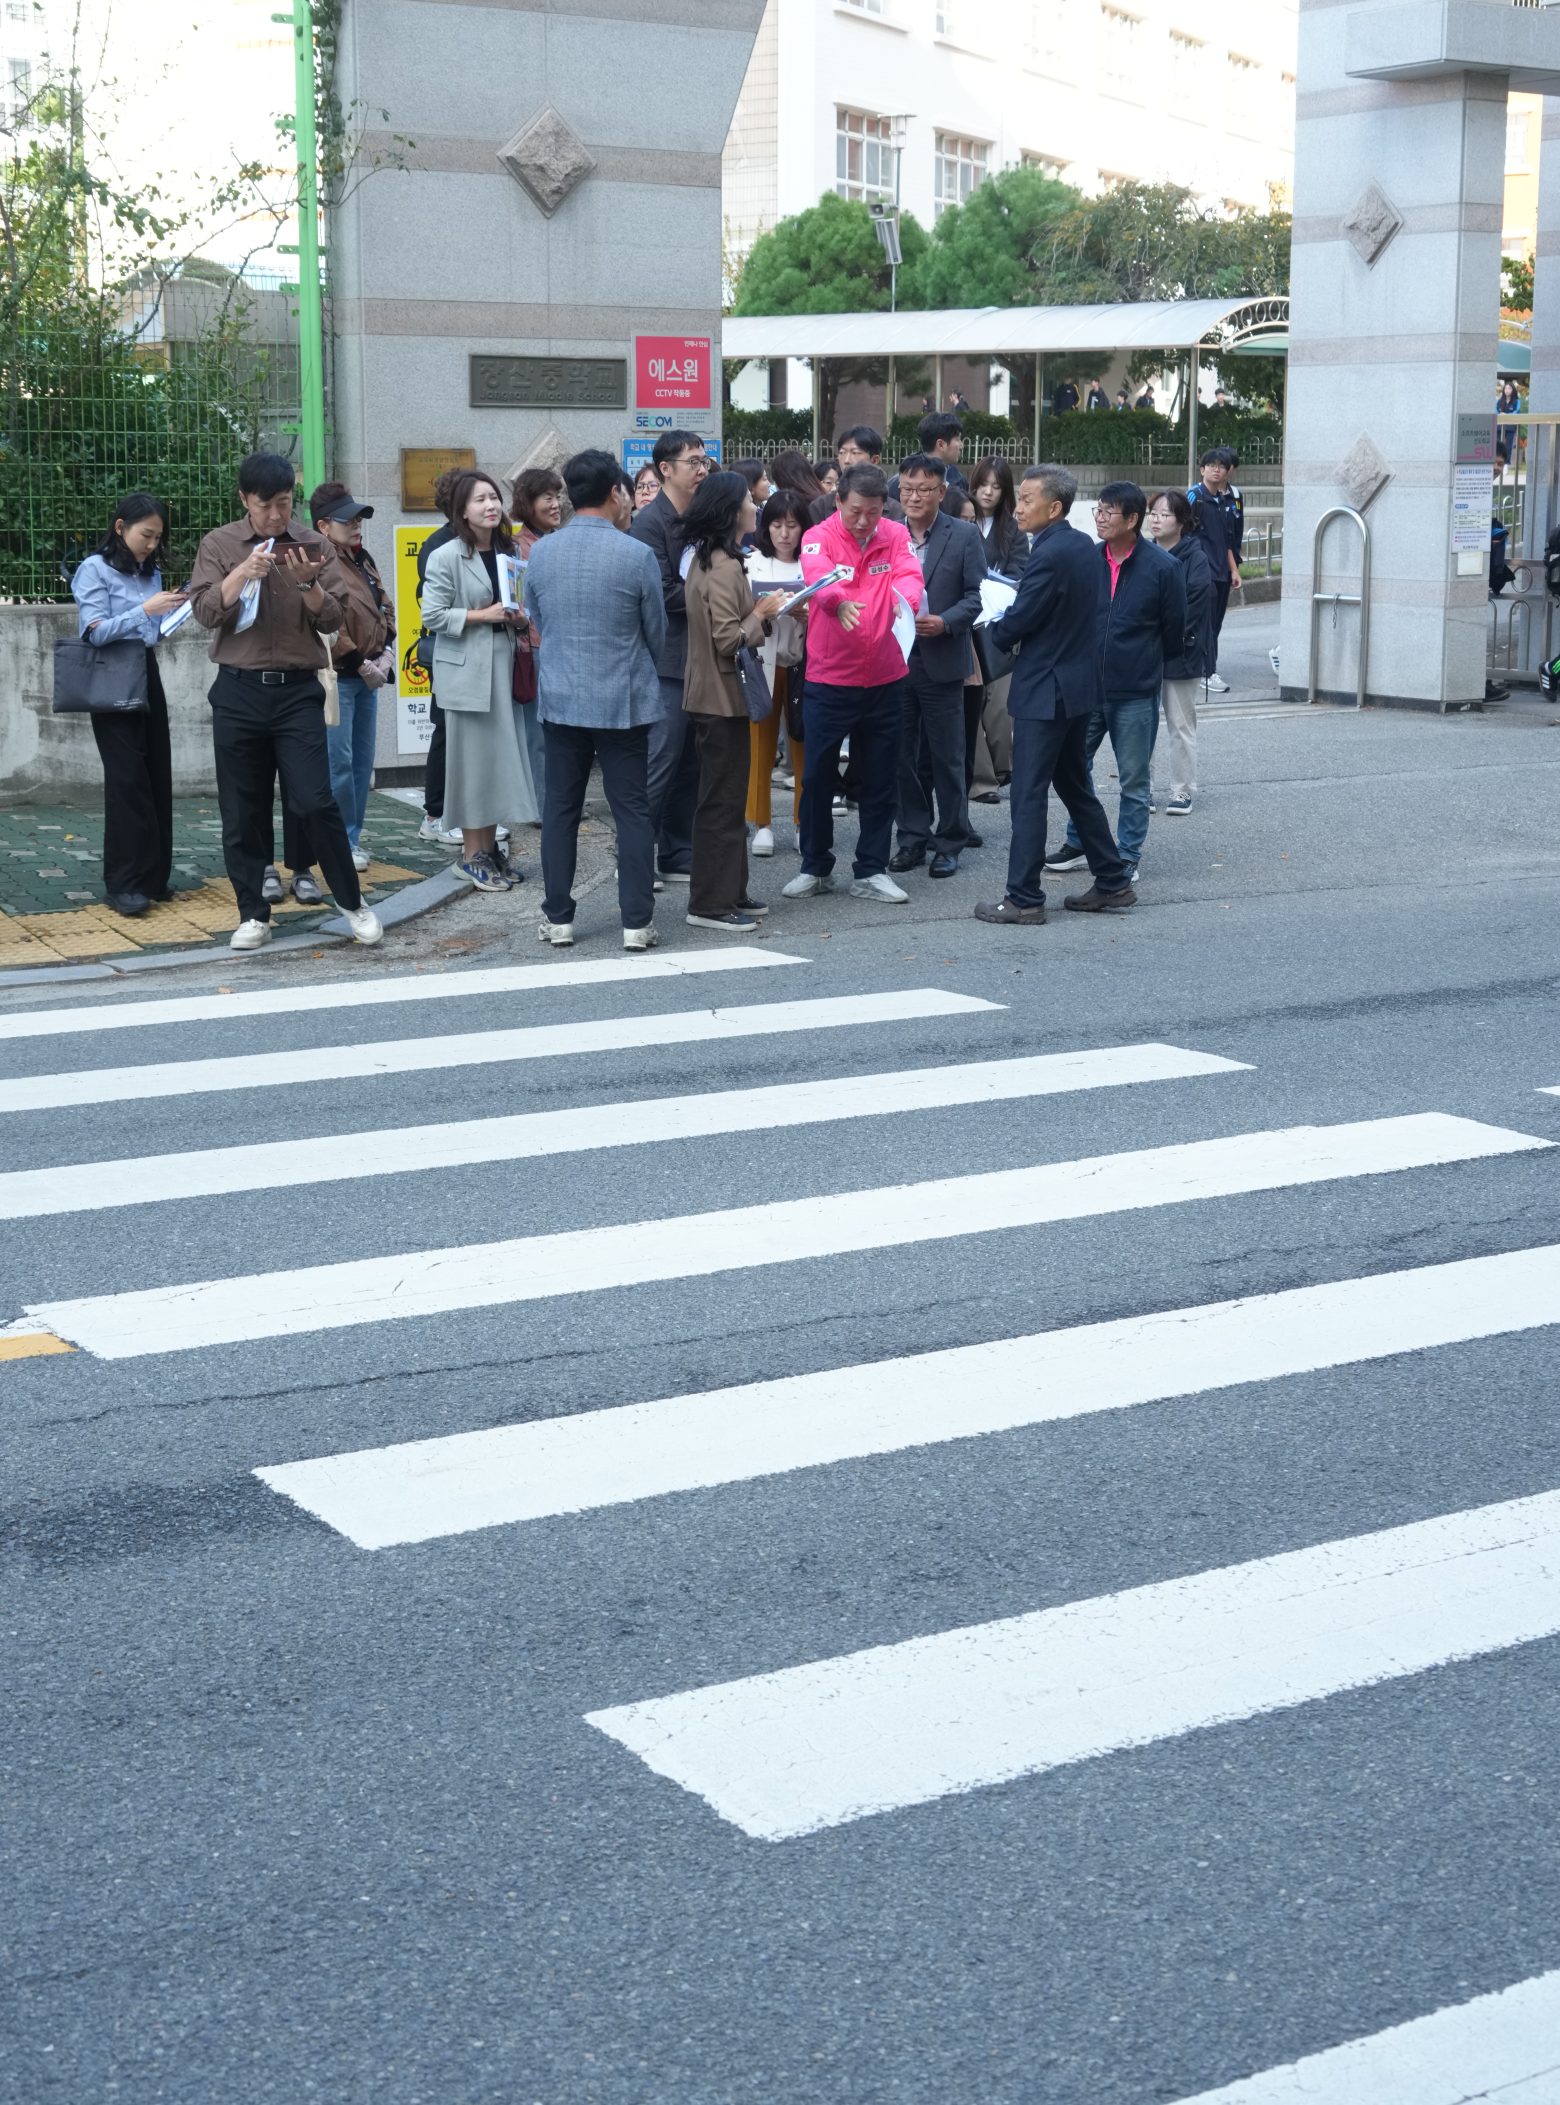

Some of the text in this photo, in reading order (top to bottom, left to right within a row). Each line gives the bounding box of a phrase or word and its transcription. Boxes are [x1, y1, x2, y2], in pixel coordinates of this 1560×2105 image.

[479, 360, 617, 390] 장산중학교
[648, 358, 698, 382] 에스원
[535, 391, 574, 402] Middle
[577, 391, 617, 402] School
[655, 388, 691, 398] CCTV 작동중
[636, 416, 672, 428] SECOM
[407, 703, 427, 715] 학교
[418, 733, 433, 741] 부산
